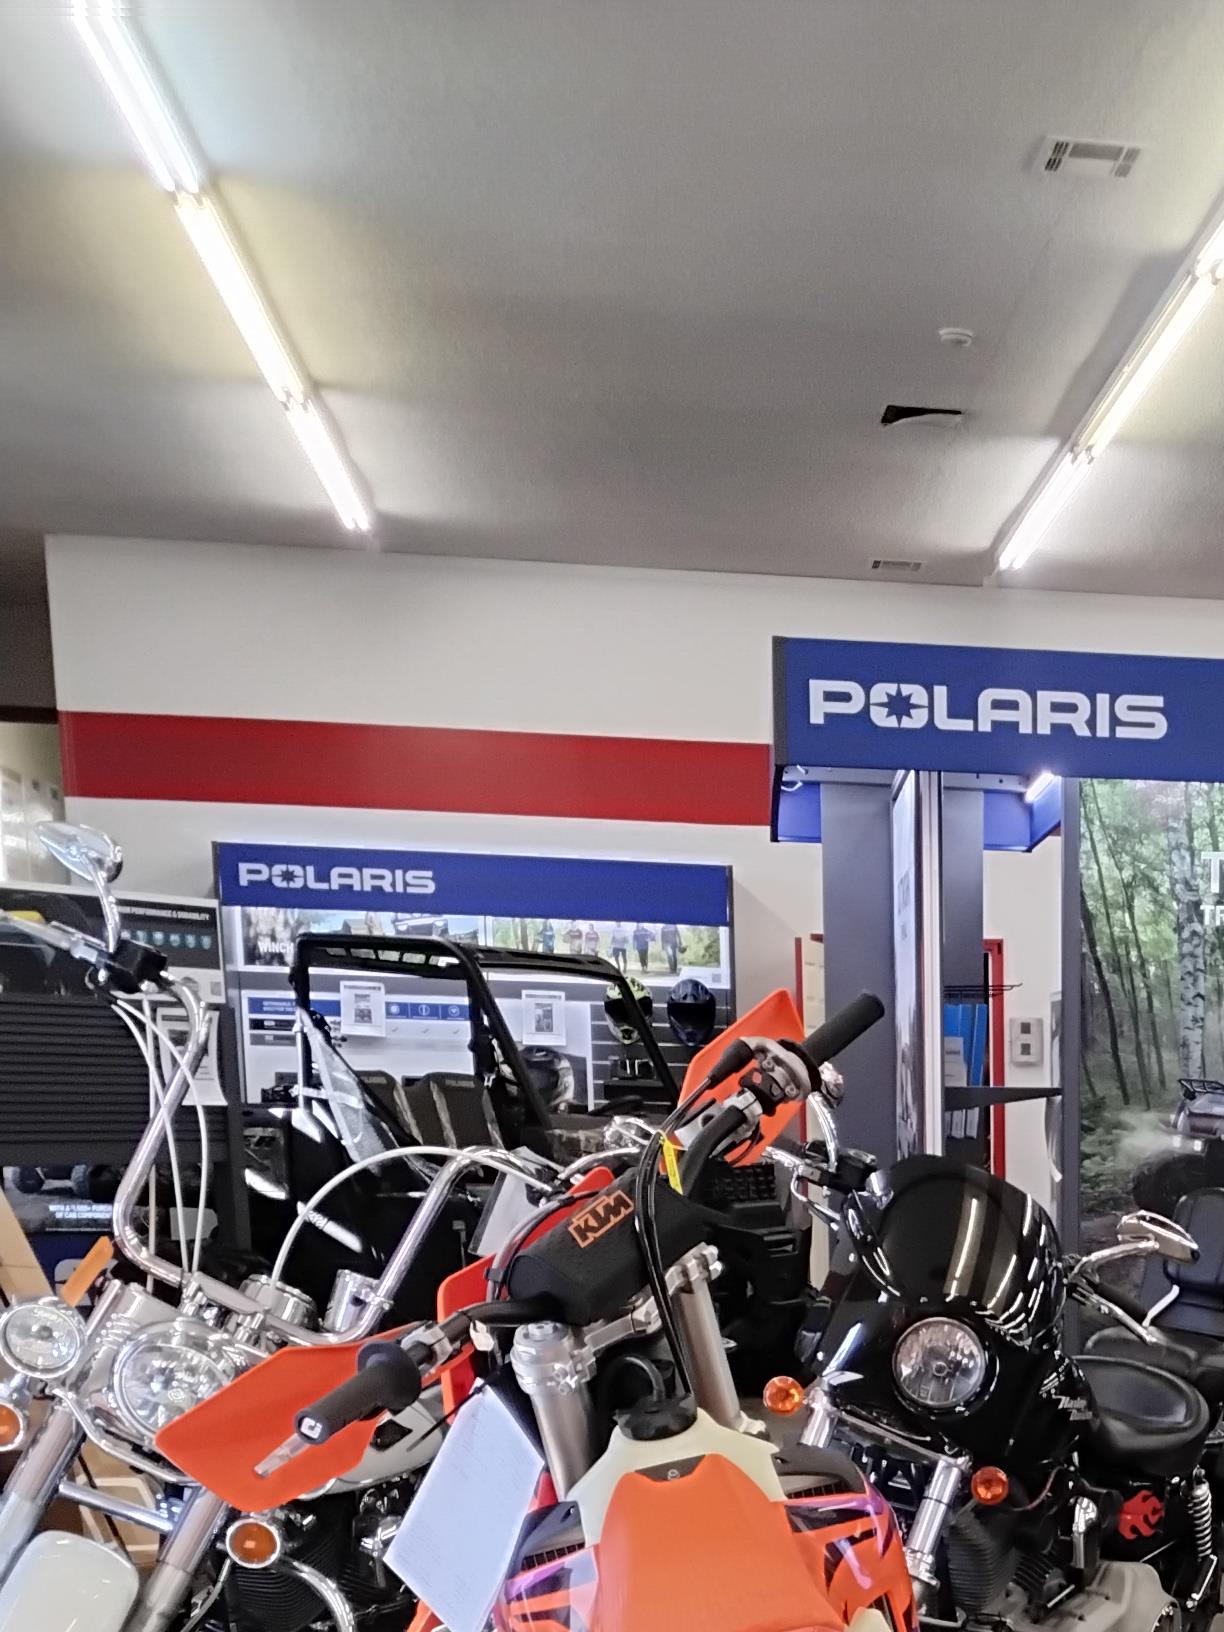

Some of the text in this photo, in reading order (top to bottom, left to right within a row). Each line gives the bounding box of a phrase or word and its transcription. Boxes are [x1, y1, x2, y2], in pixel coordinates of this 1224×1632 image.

[808, 678, 1169, 741] POLARIS
[238, 861, 436, 895] POLARIS
[568, 1189, 635, 1248] KTM
